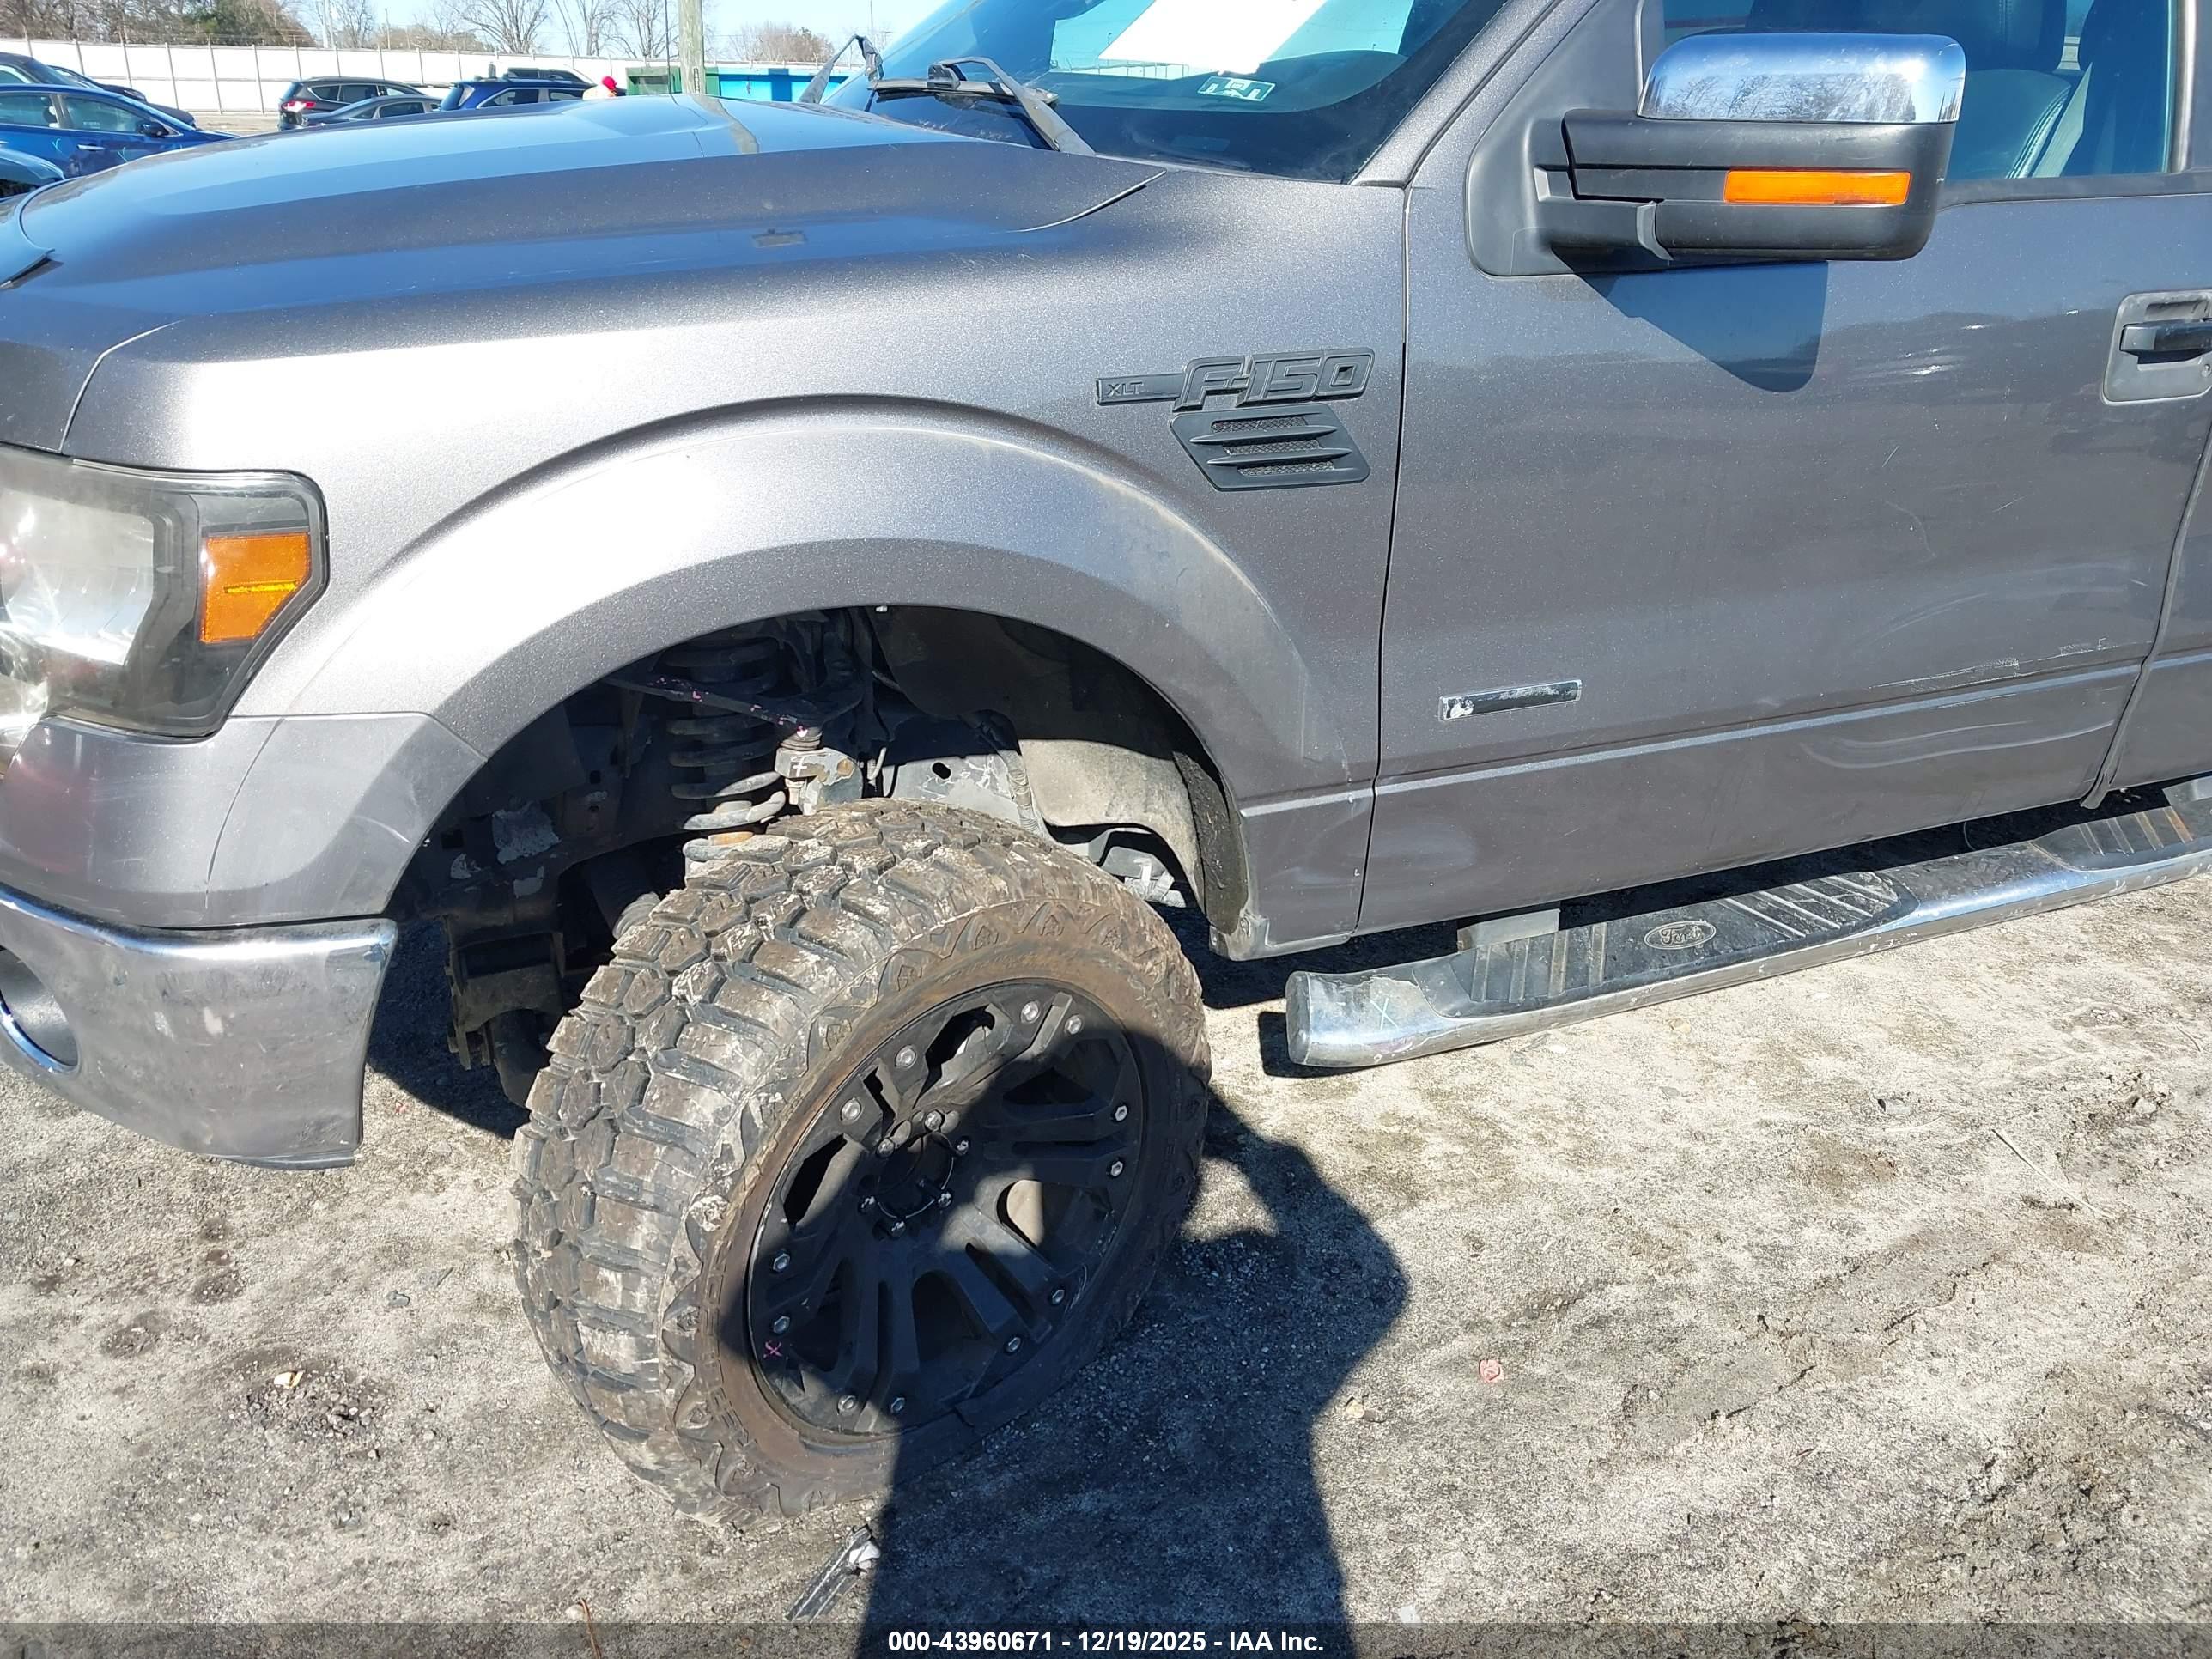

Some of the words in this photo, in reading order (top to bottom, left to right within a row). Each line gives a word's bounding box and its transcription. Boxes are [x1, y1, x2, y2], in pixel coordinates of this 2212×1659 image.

[1107, 379, 1144, 396] XLT
[1173, 348, 1374, 412] F-150
[1658, 925, 1705, 946] Ford
